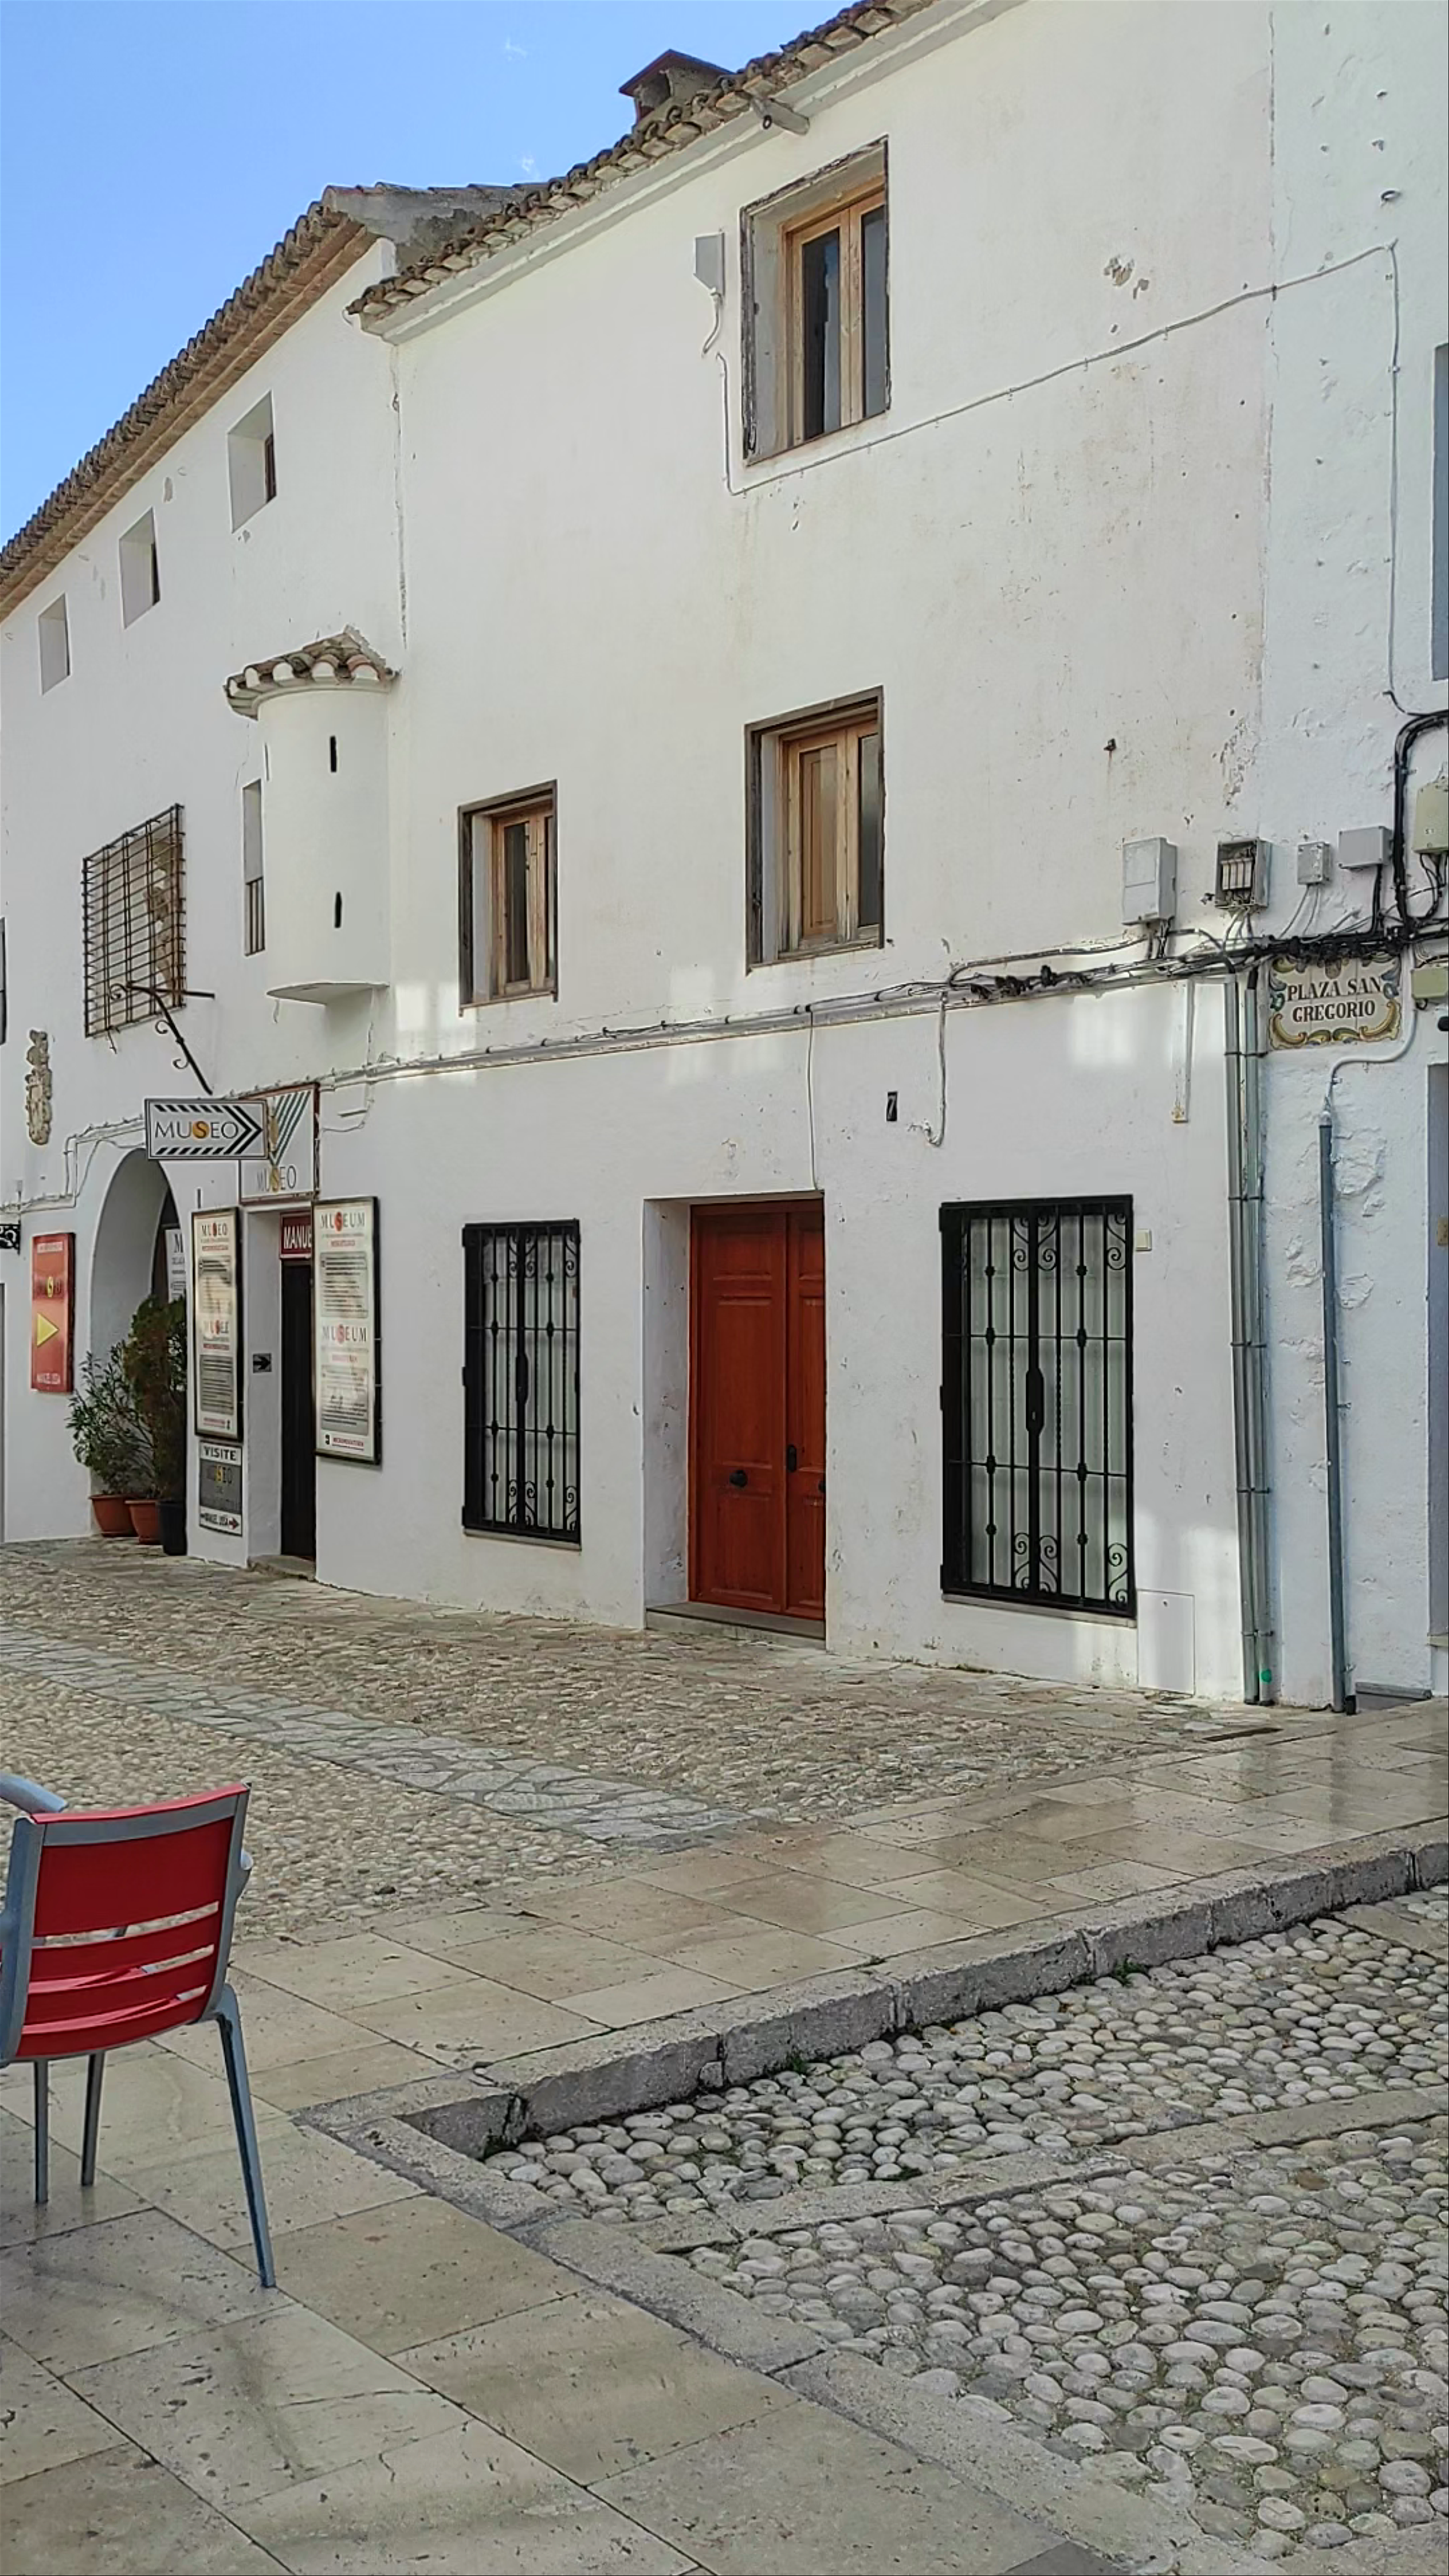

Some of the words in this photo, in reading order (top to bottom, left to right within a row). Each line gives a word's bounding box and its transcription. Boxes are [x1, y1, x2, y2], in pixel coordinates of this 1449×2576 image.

[1287, 980, 1342, 1002] PLAZA
[1347, 977, 1382, 995] SAN
[1292, 1000, 1375, 1022] GREGORIO
[887, 1093, 897, 1121] 7
[154, 1121, 239, 1139] MUSEO
[257, 1165, 297, 1192] MUSEO
[202, 1223, 228, 1236] MUSEO
[321, 1212, 365, 1232] MUSEUM
[321, 1324, 367, 1344] MUSEUM
[203, 1446, 237, 1461] VISITE
